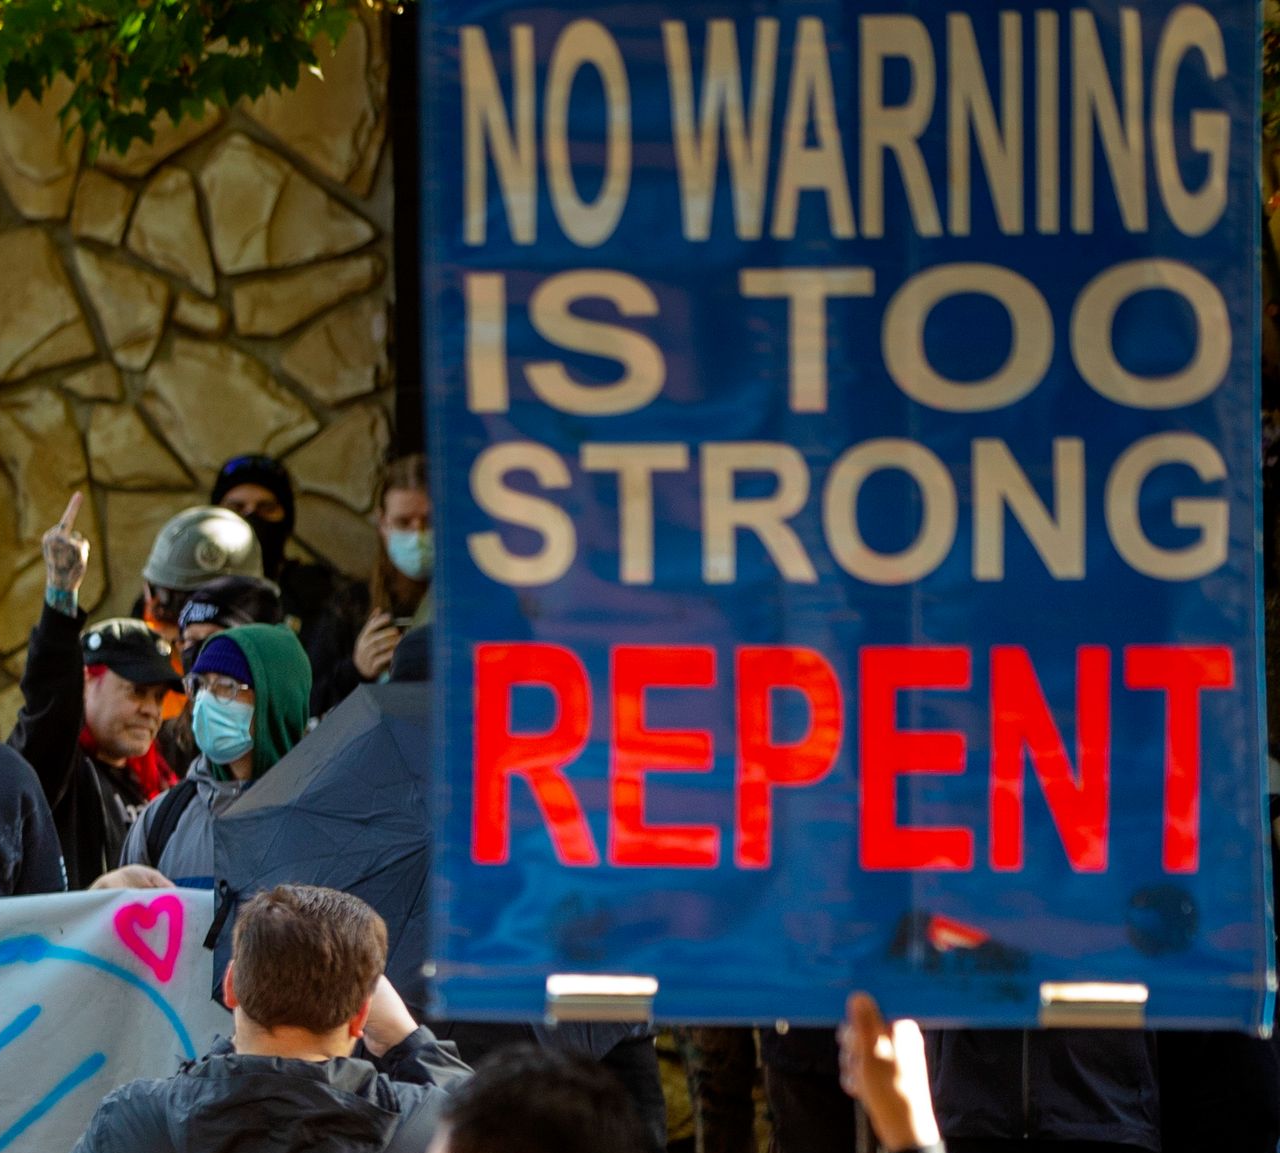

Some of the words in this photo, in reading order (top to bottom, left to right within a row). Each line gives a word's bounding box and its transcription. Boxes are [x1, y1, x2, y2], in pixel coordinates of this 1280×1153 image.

[460, 19, 633, 248] NO
[662, 3, 1231, 243] WARNING
[464, 268, 667, 417] IS
[739, 258, 1233, 414] TOO
[465, 431, 1230, 587] STRONG
[471, 641, 1236, 874] REPENT
